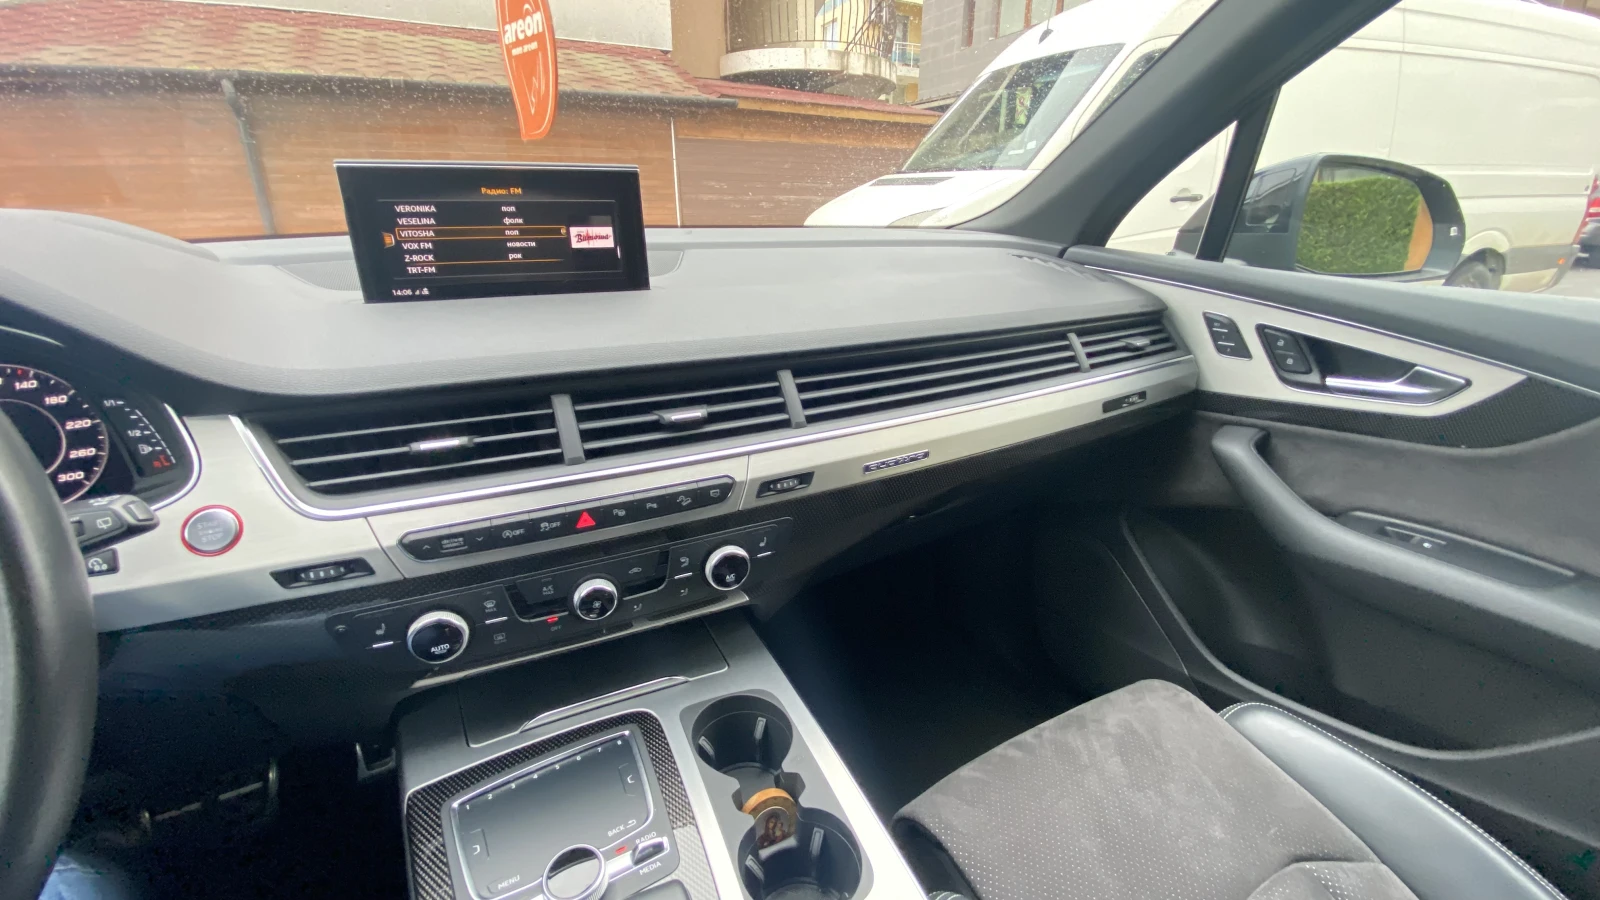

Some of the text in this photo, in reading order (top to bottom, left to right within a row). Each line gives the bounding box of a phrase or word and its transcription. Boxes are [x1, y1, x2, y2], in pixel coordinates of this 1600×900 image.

[504, 11, 543, 44] areon
[481, 187, 522, 195] Радио: FM
[394, 205, 437, 213] VERONIKA
[397, 217, 436, 225] VESELINA
[503, 216, 524, 226] фолк
[400, 230, 436, 238] VITOSHA
[402, 242, 433, 250] VOX FM
[404, 254, 436, 262] Z-ROCK
[407, 266, 436, 274] TRT-FM
[392, 288, 413, 296] 14:06
[14, 380, 38, 390] 140
[44, 395, 68, 405] 180
[65, 419, 92, 430] 220
[127, 430, 142, 438] 1/2
[69, 447, 96, 459] 260
[57, 471, 84, 482] 300
[430, 643, 450, 653] AUTO
[607, 824, 625, 837] BACK
[635, 831, 657, 844] RADIO
[639, 861, 662, 875] MEDIA
[497, 875, 520, 889] MENU
